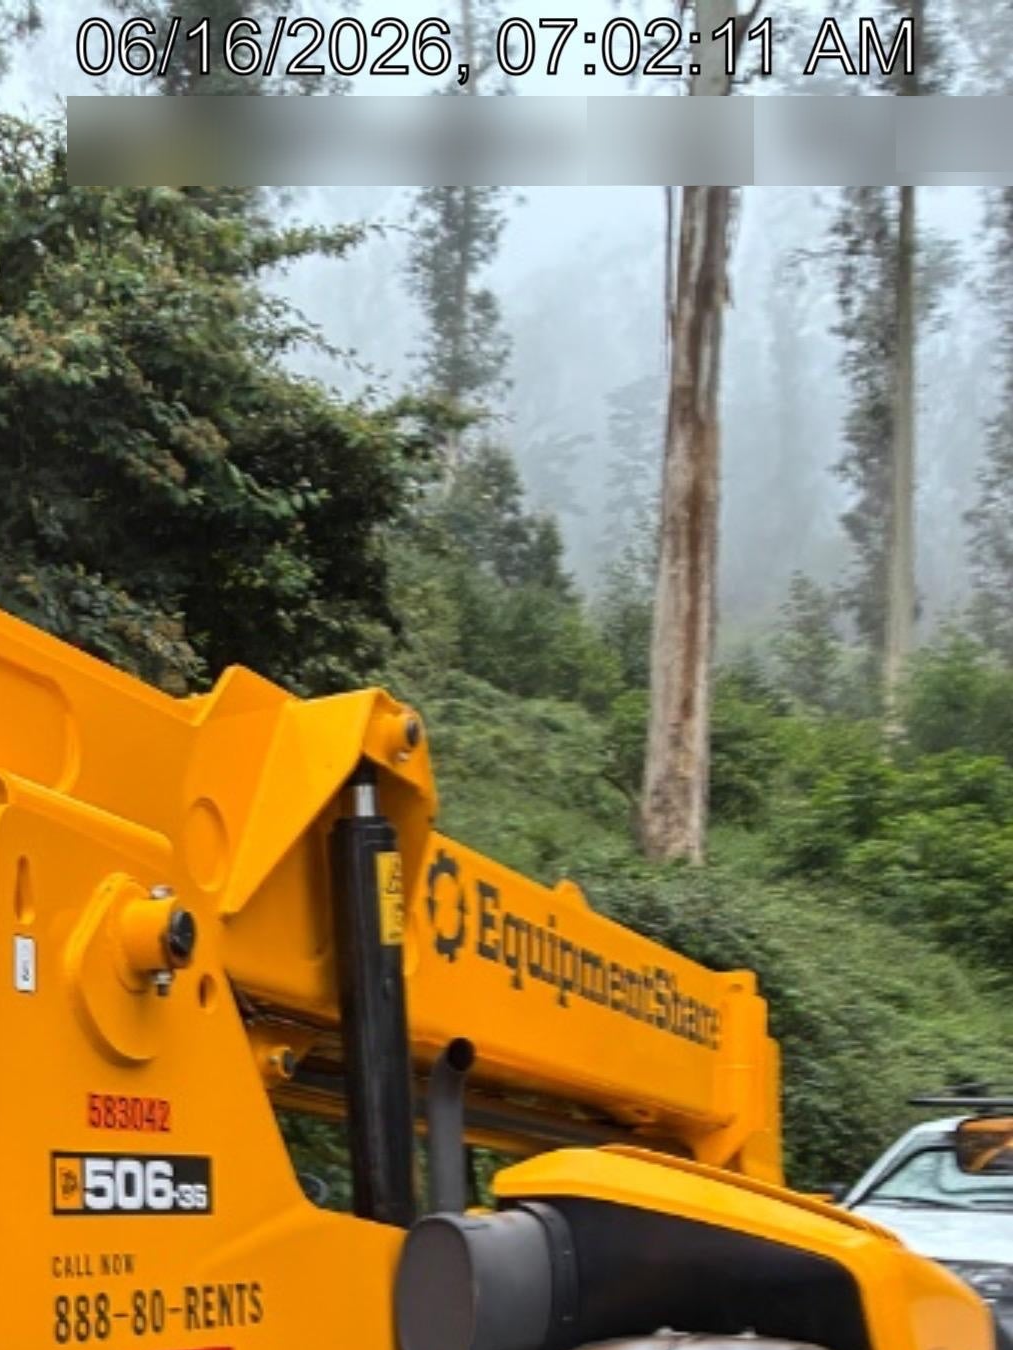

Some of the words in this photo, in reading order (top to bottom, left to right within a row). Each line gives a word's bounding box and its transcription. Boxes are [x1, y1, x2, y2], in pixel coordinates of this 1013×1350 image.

[476, 879, 719, 1050] EquipmentShare
[89, 1092, 171, 1133] 583042
[52, 1255, 94, 1278] CALL
[100, 1253, 135, 1276] NOW
[54, 1281, 263, 1344] 888-80-RENTS
